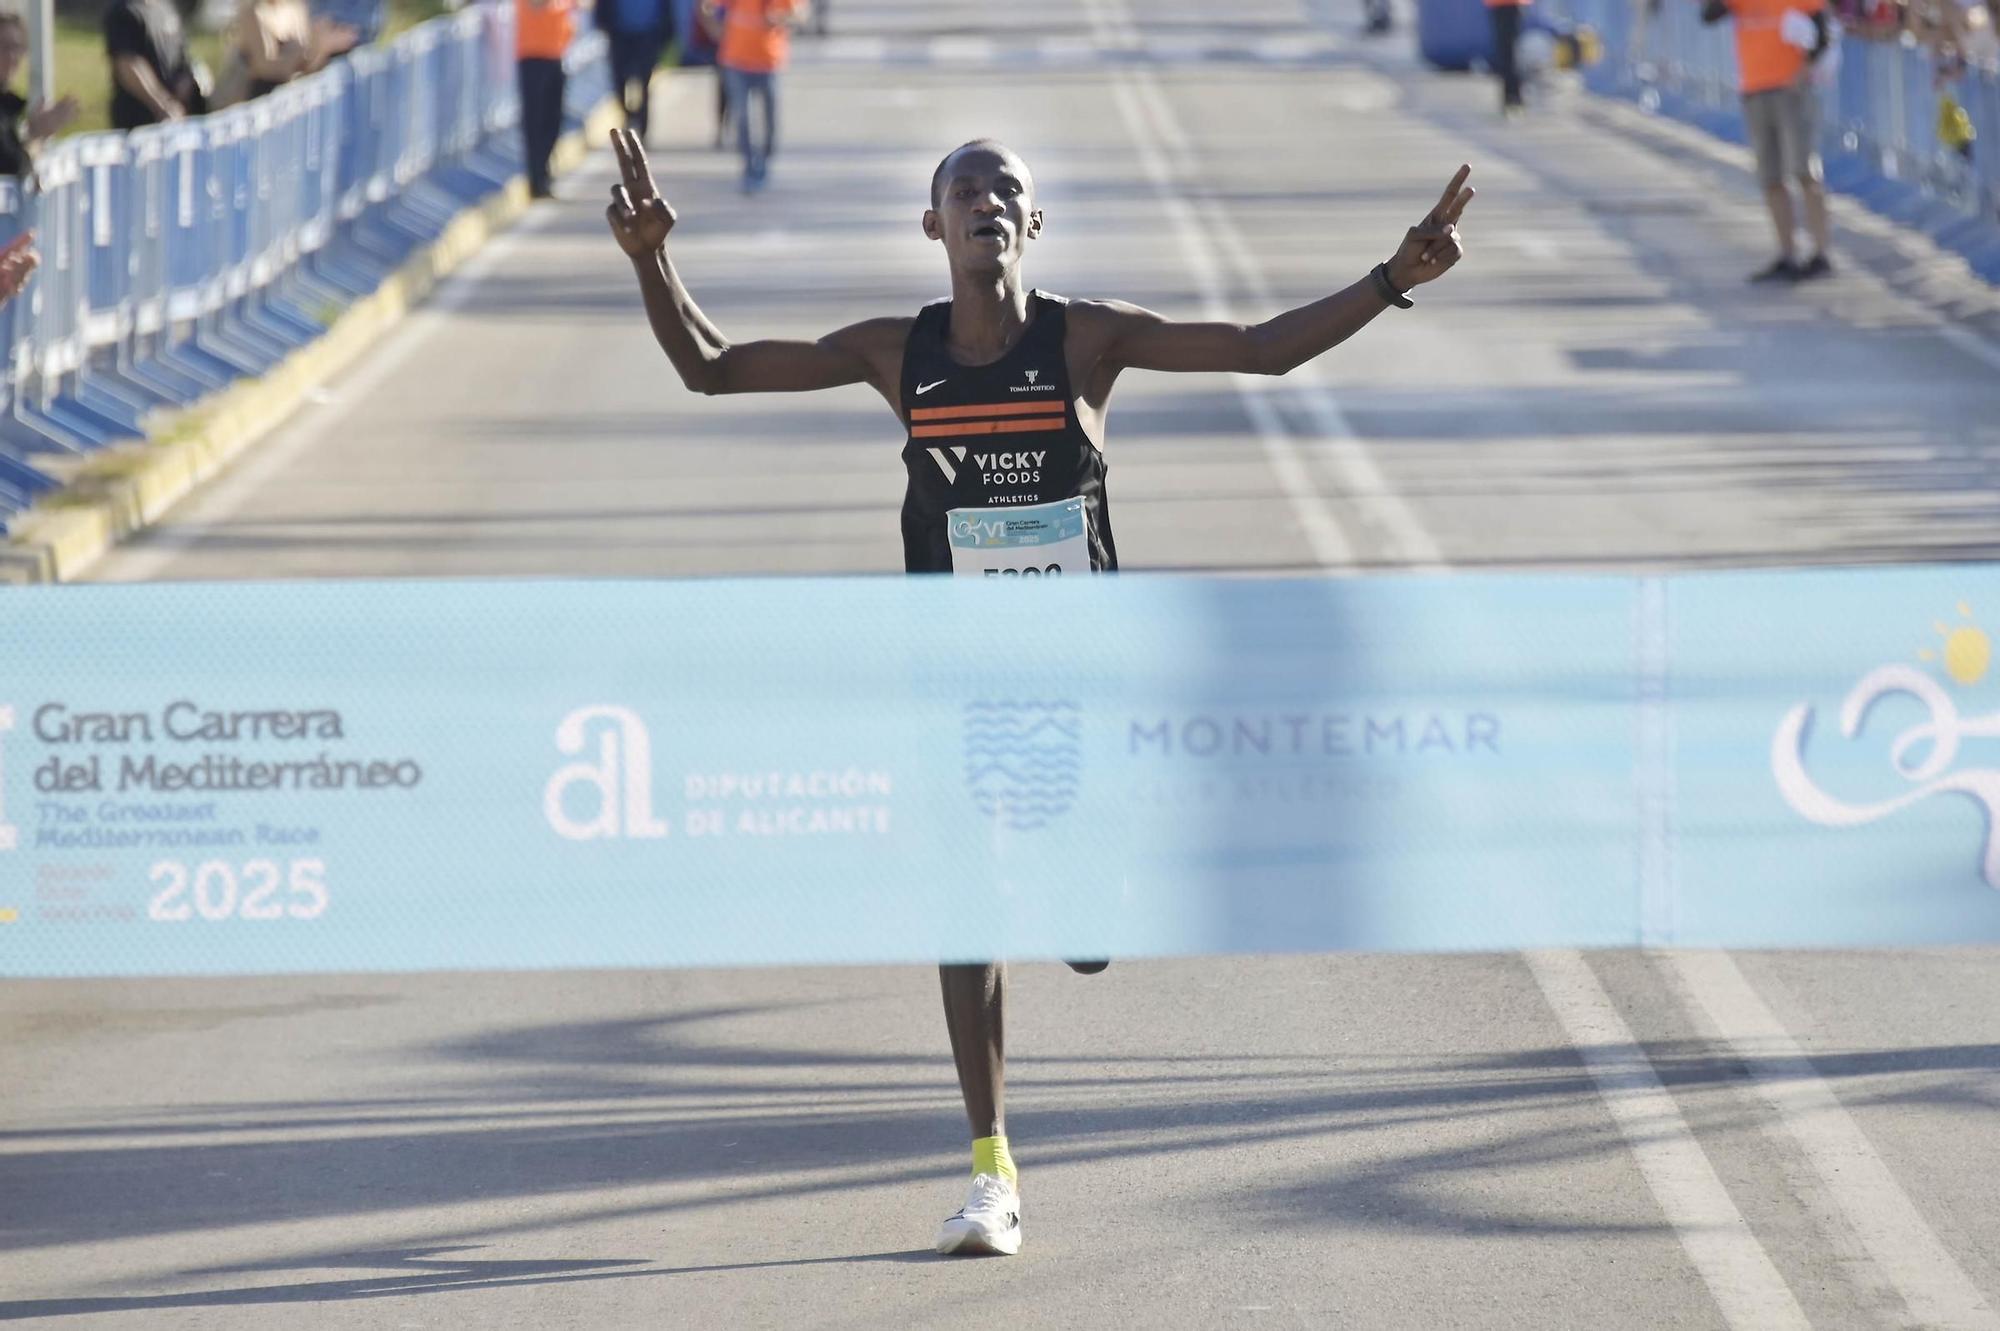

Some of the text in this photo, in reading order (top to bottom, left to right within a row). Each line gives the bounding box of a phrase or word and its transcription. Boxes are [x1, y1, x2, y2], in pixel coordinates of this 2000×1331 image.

[973, 451, 1046, 470] VICKY
[983, 471, 1040, 485] FOODS
[988, 495, 1038, 503] ATHLETICS
[33, 700, 343, 744] Gran Carrera
[1128, 711, 1502, 757] MONTEMAR
[33, 753, 421, 793] del Mediterráneo
[685, 767, 892, 799] DIPUTACIÓN
[35, 800, 216, 823] The Greatest
[685, 805, 891, 837] DE ALICANTE
[35, 823, 320, 850] Mediterranean Race
[148, 858, 330, 922] 2025
